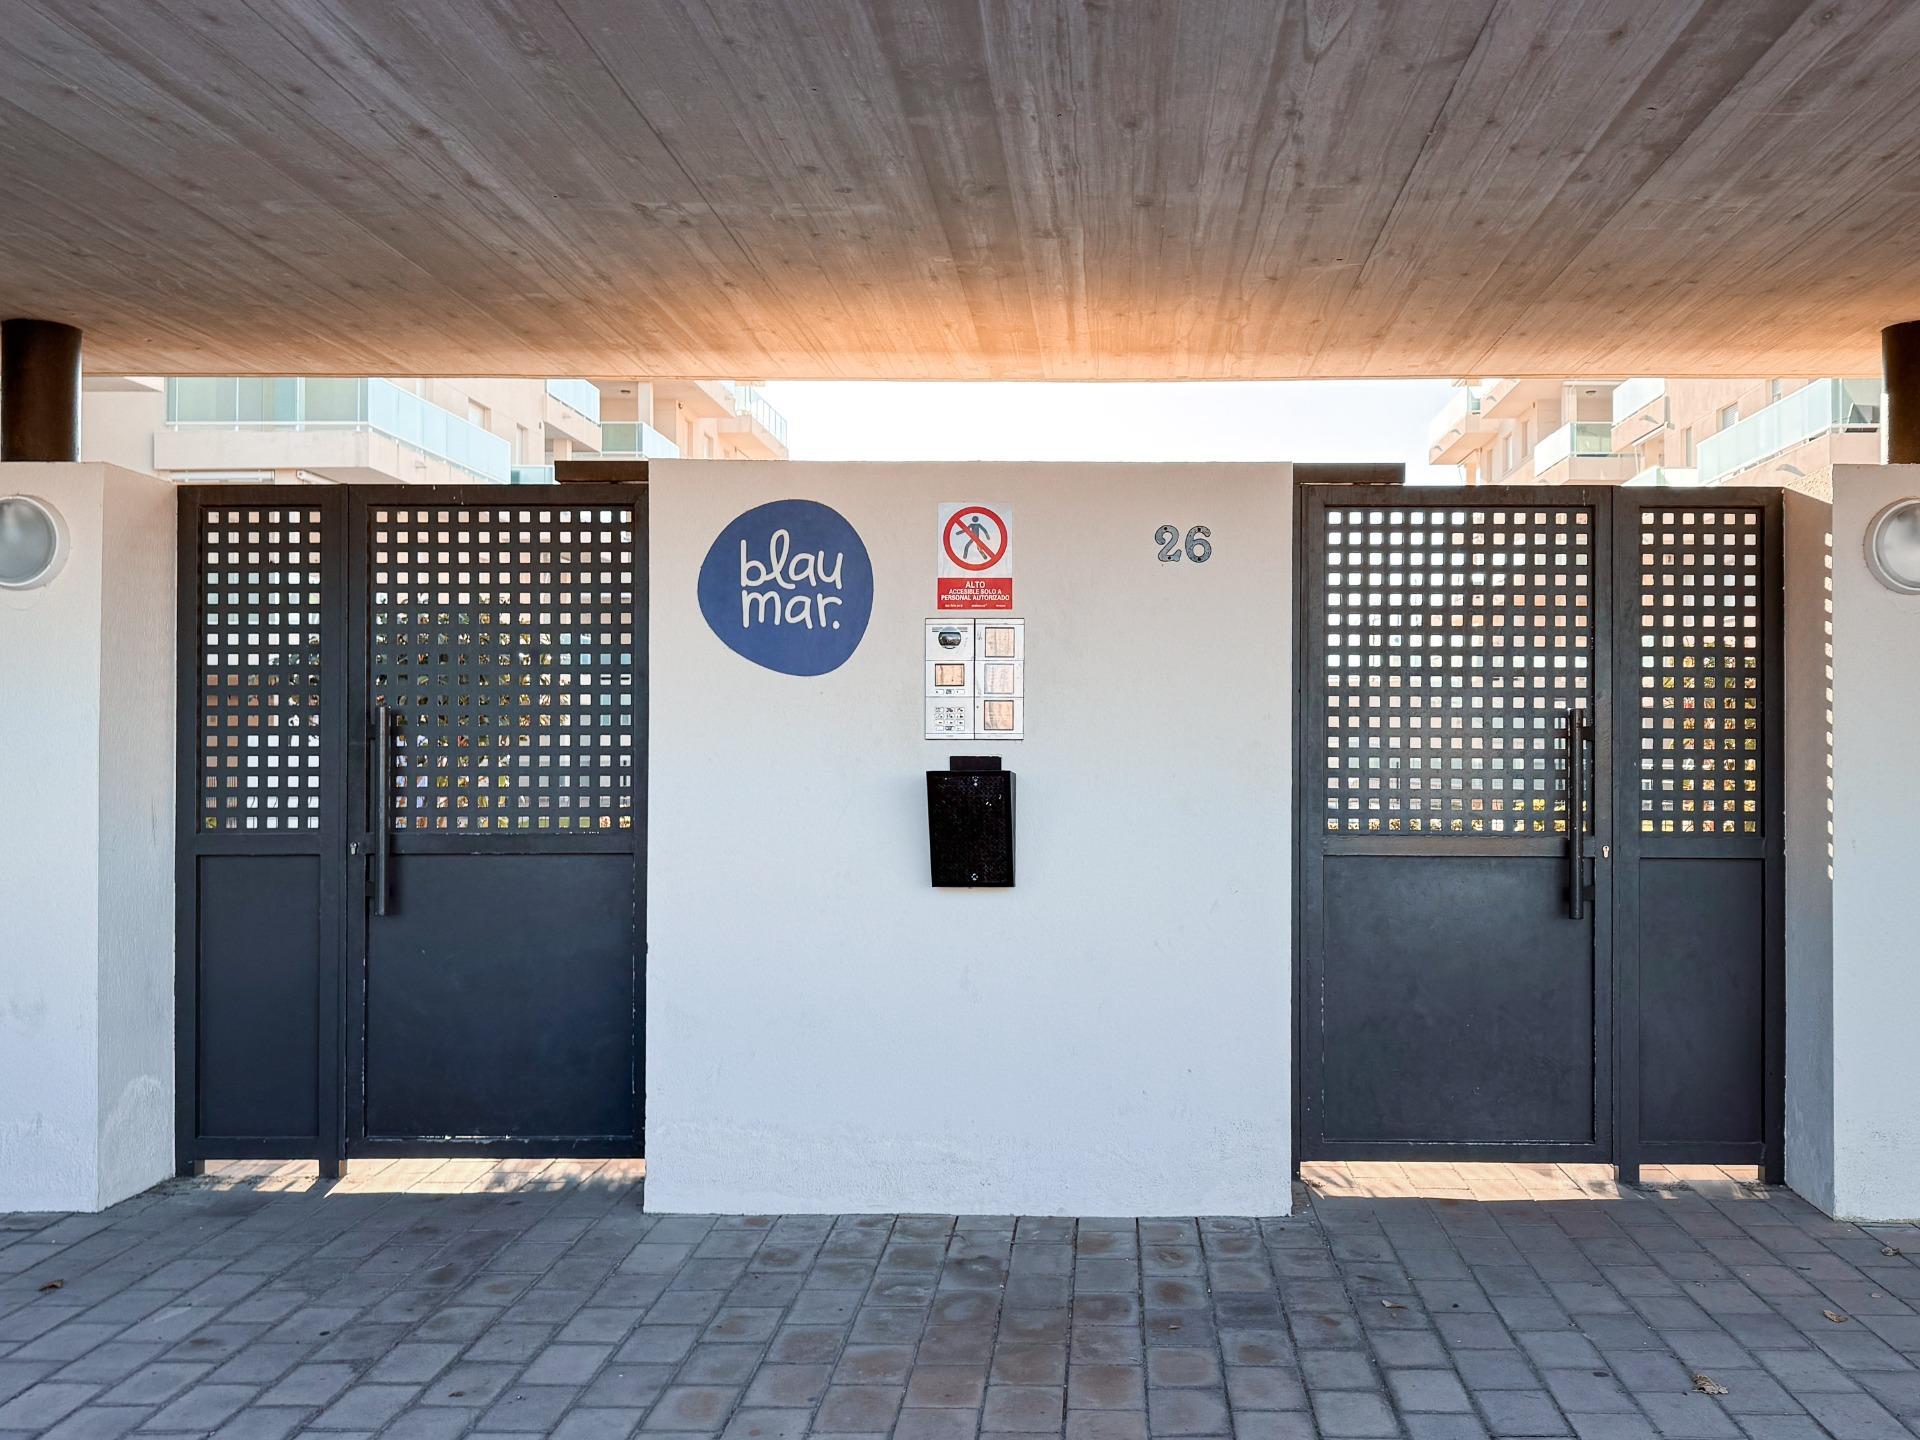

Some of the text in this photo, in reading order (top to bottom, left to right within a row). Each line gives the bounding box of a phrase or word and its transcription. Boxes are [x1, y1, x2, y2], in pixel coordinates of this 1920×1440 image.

[740, 528, 844, 590] blau
[1155, 525, 1212, 563] 26
[965, 580, 986, 589] ALTO
[741, 589, 843, 630] mar.
